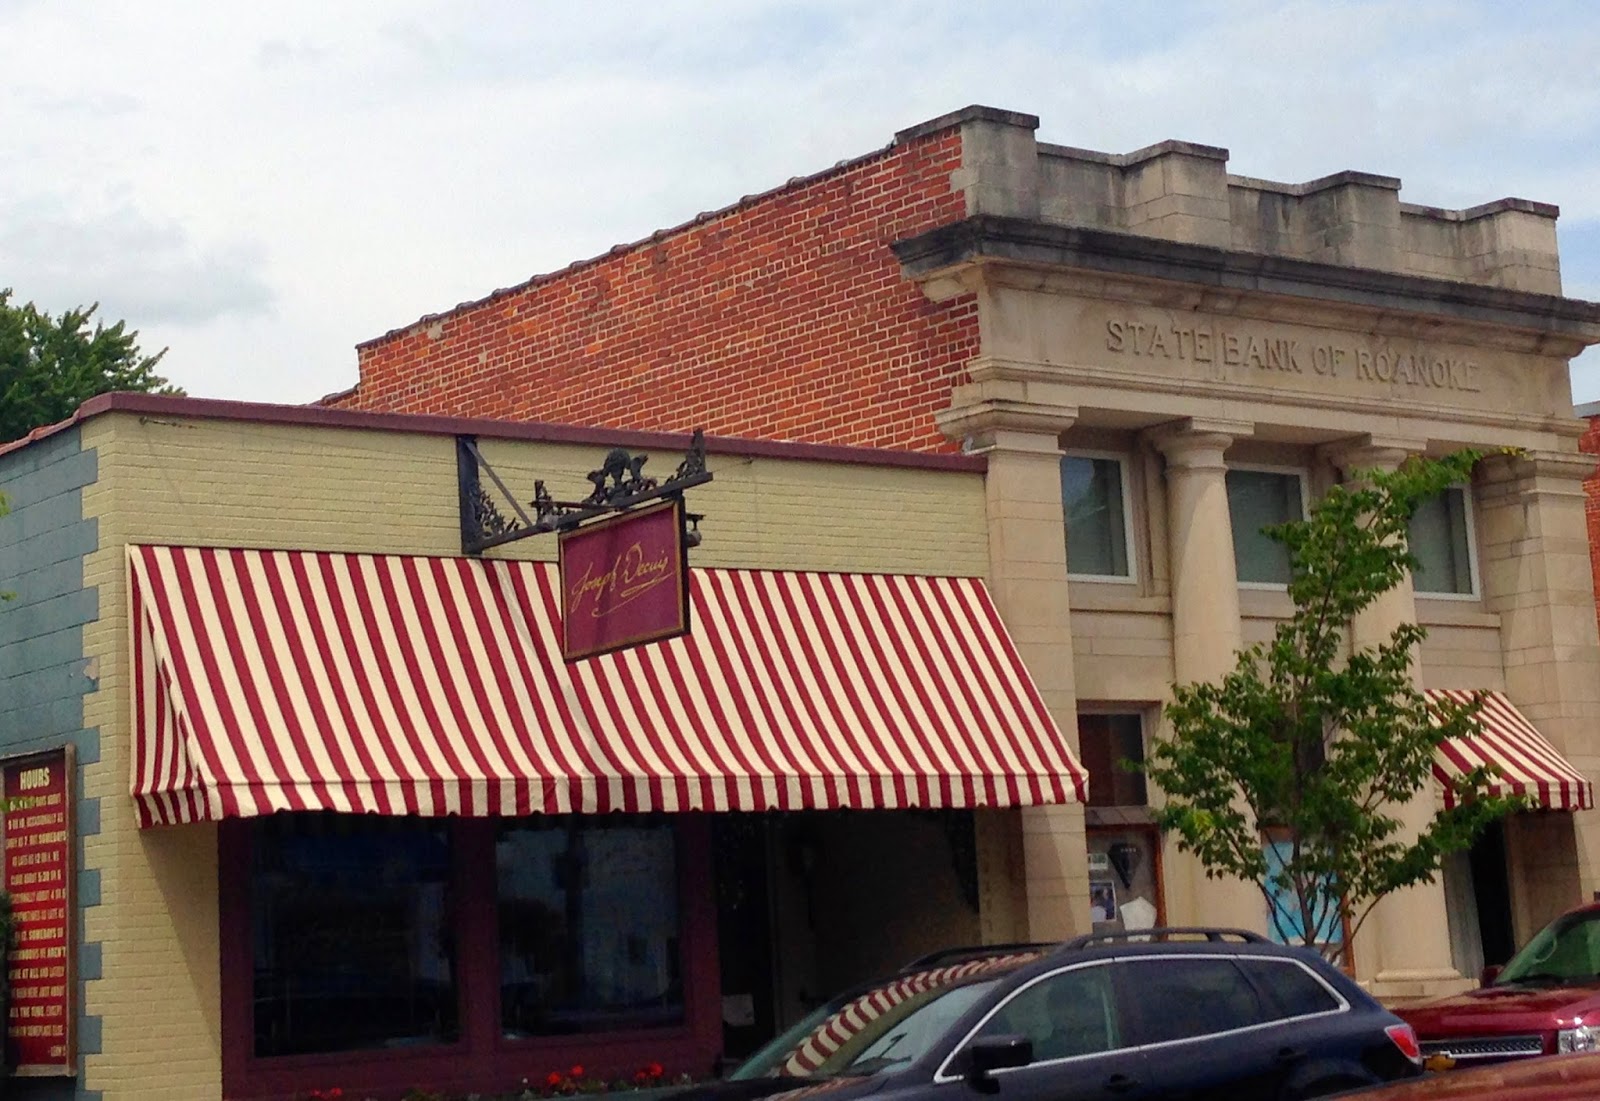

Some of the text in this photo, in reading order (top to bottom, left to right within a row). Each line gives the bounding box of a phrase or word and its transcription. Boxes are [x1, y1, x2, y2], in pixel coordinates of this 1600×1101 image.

[1105, 320, 1482, 393] STATE BANK OF ROANOKE
[20, 767, 50, 791] HOURS
